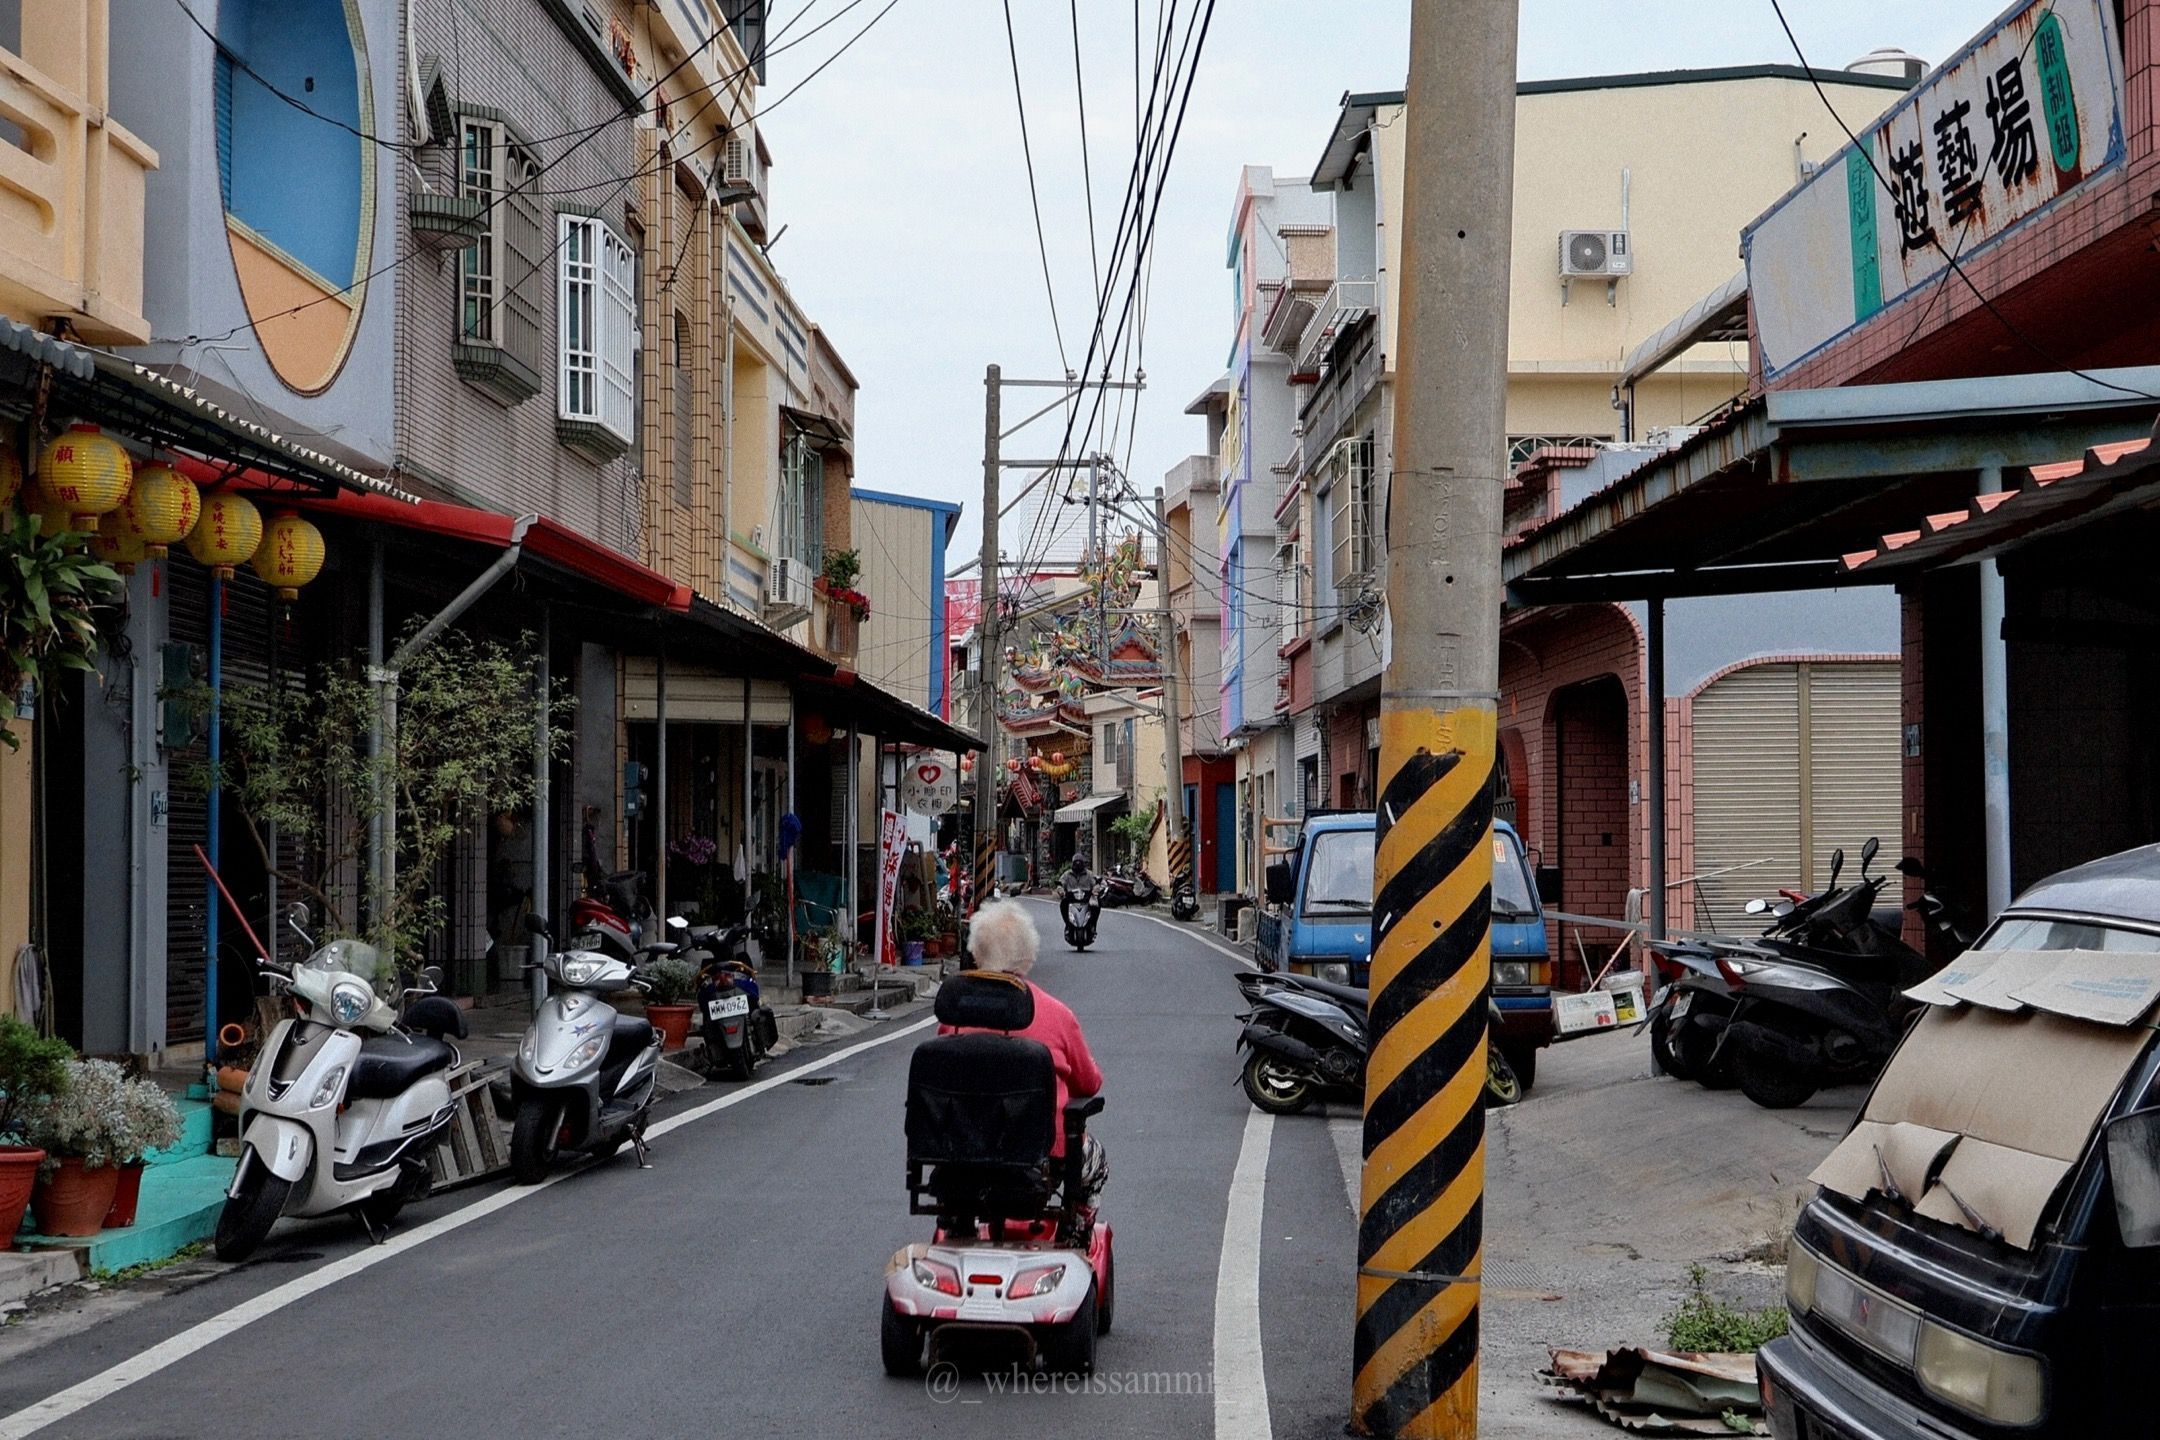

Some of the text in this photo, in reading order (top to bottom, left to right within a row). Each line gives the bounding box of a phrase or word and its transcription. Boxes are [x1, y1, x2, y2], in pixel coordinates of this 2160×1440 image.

[2038, 27, 2074, 158] 限制級
[1889, 56, 2038, 259] 遊藝場
[54, 445, 80, 503] 顧問
[212, 502, 229, 550] 合境平安
